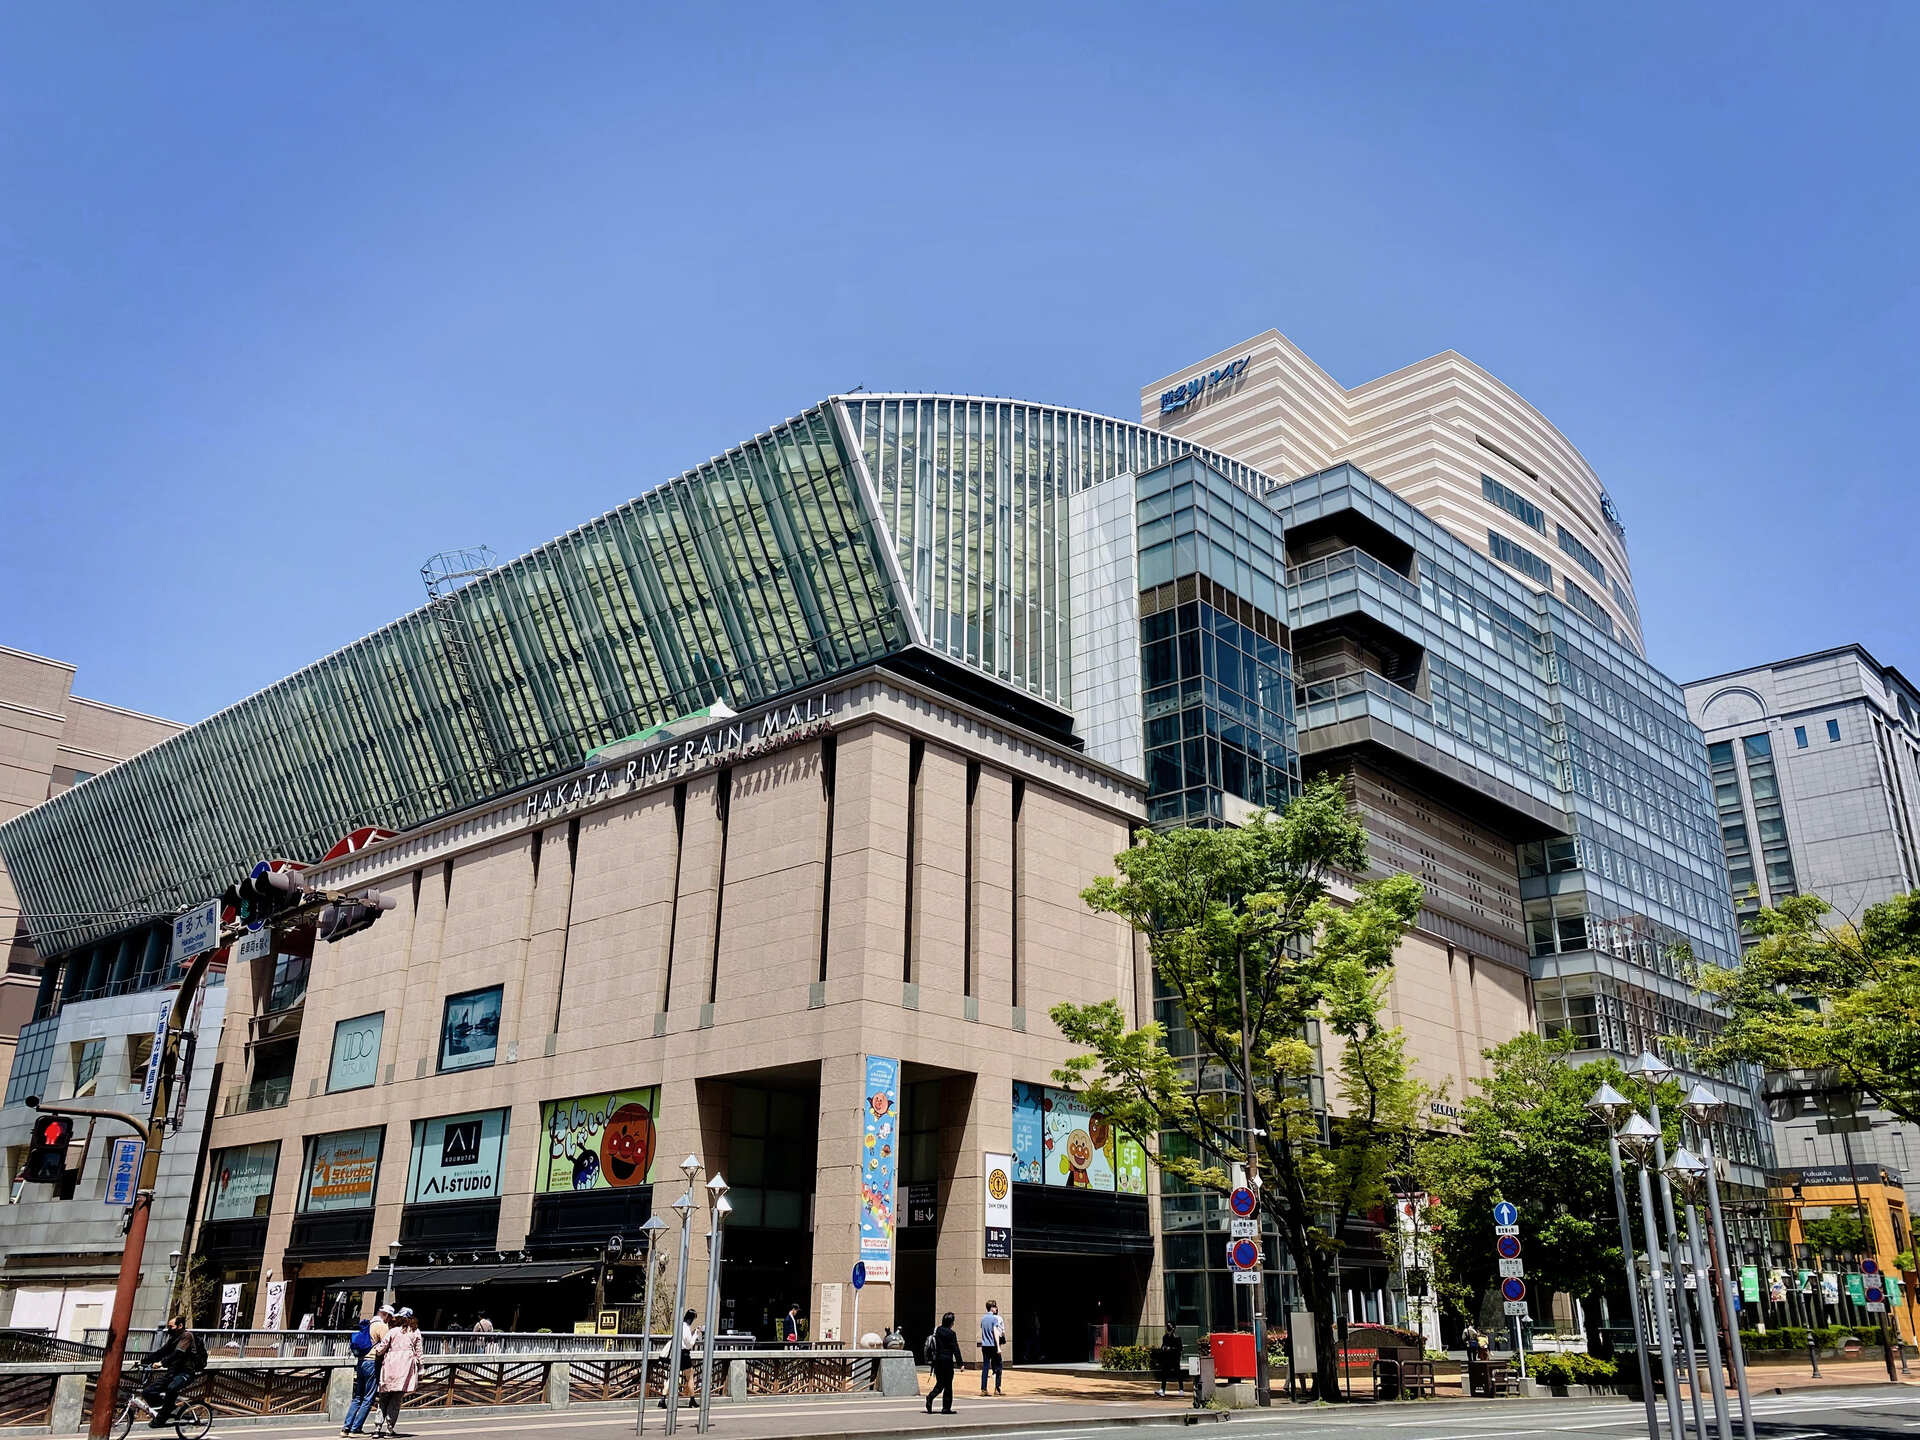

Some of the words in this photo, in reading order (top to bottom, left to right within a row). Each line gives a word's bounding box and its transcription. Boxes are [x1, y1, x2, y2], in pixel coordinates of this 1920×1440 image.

[526, 769, 611, 816] HAKATA
[626, 723, 744, 782] RIVERAIN
[761, 693, 834, 737] MALL
[343, 1029, 375, 1062] IDC
[1016, 1133, 1033, 1153] 5F
[1123, 1148, 1137, 1165] 5F
[332, 1167, 374, 1179] Studio
[1237, 1274, 1258, 1282] 2-16
